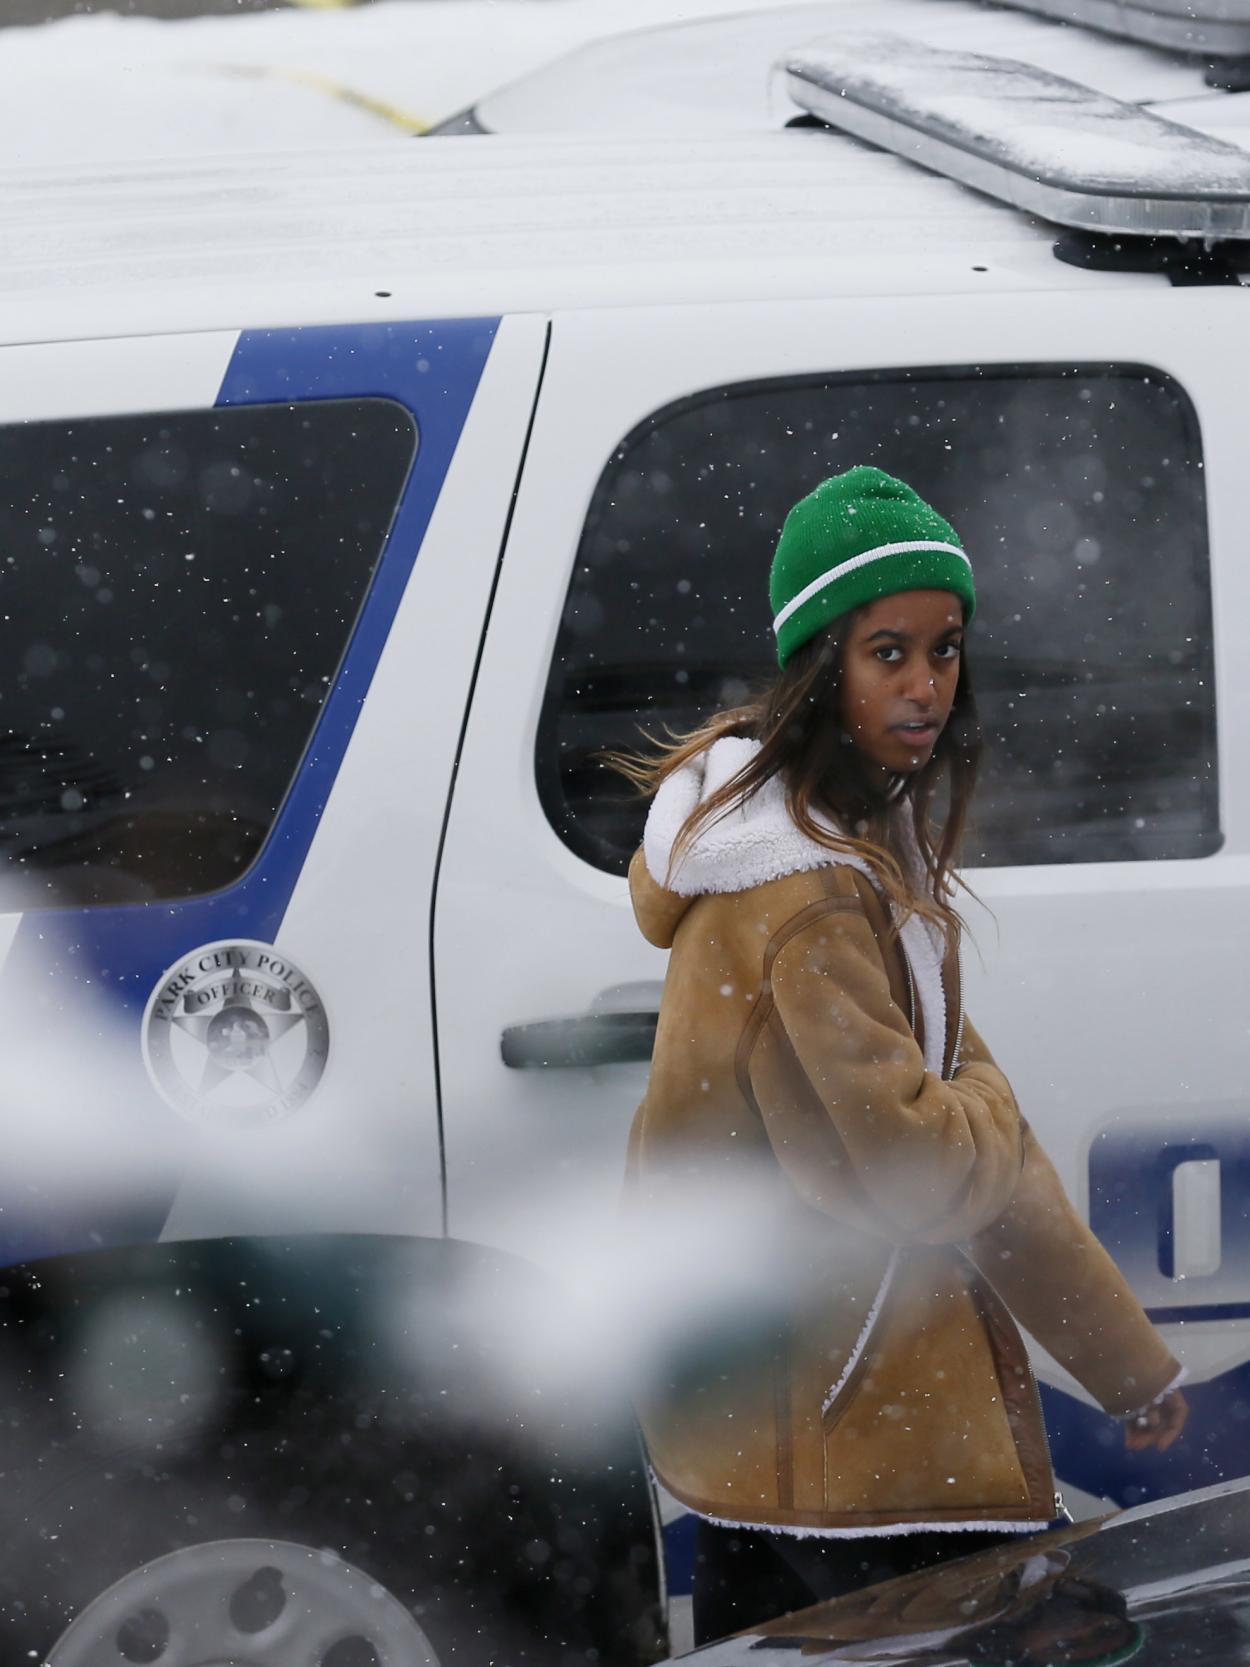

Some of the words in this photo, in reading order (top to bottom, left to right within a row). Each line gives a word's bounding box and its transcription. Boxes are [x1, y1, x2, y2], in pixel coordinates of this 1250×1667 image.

[155, 968, 195, 1021] PARK
[198, 951, 250, 973] CITY
[257, 954, 321, 1018] POLICE
[197, 982, 276, 1006] OFFICER
